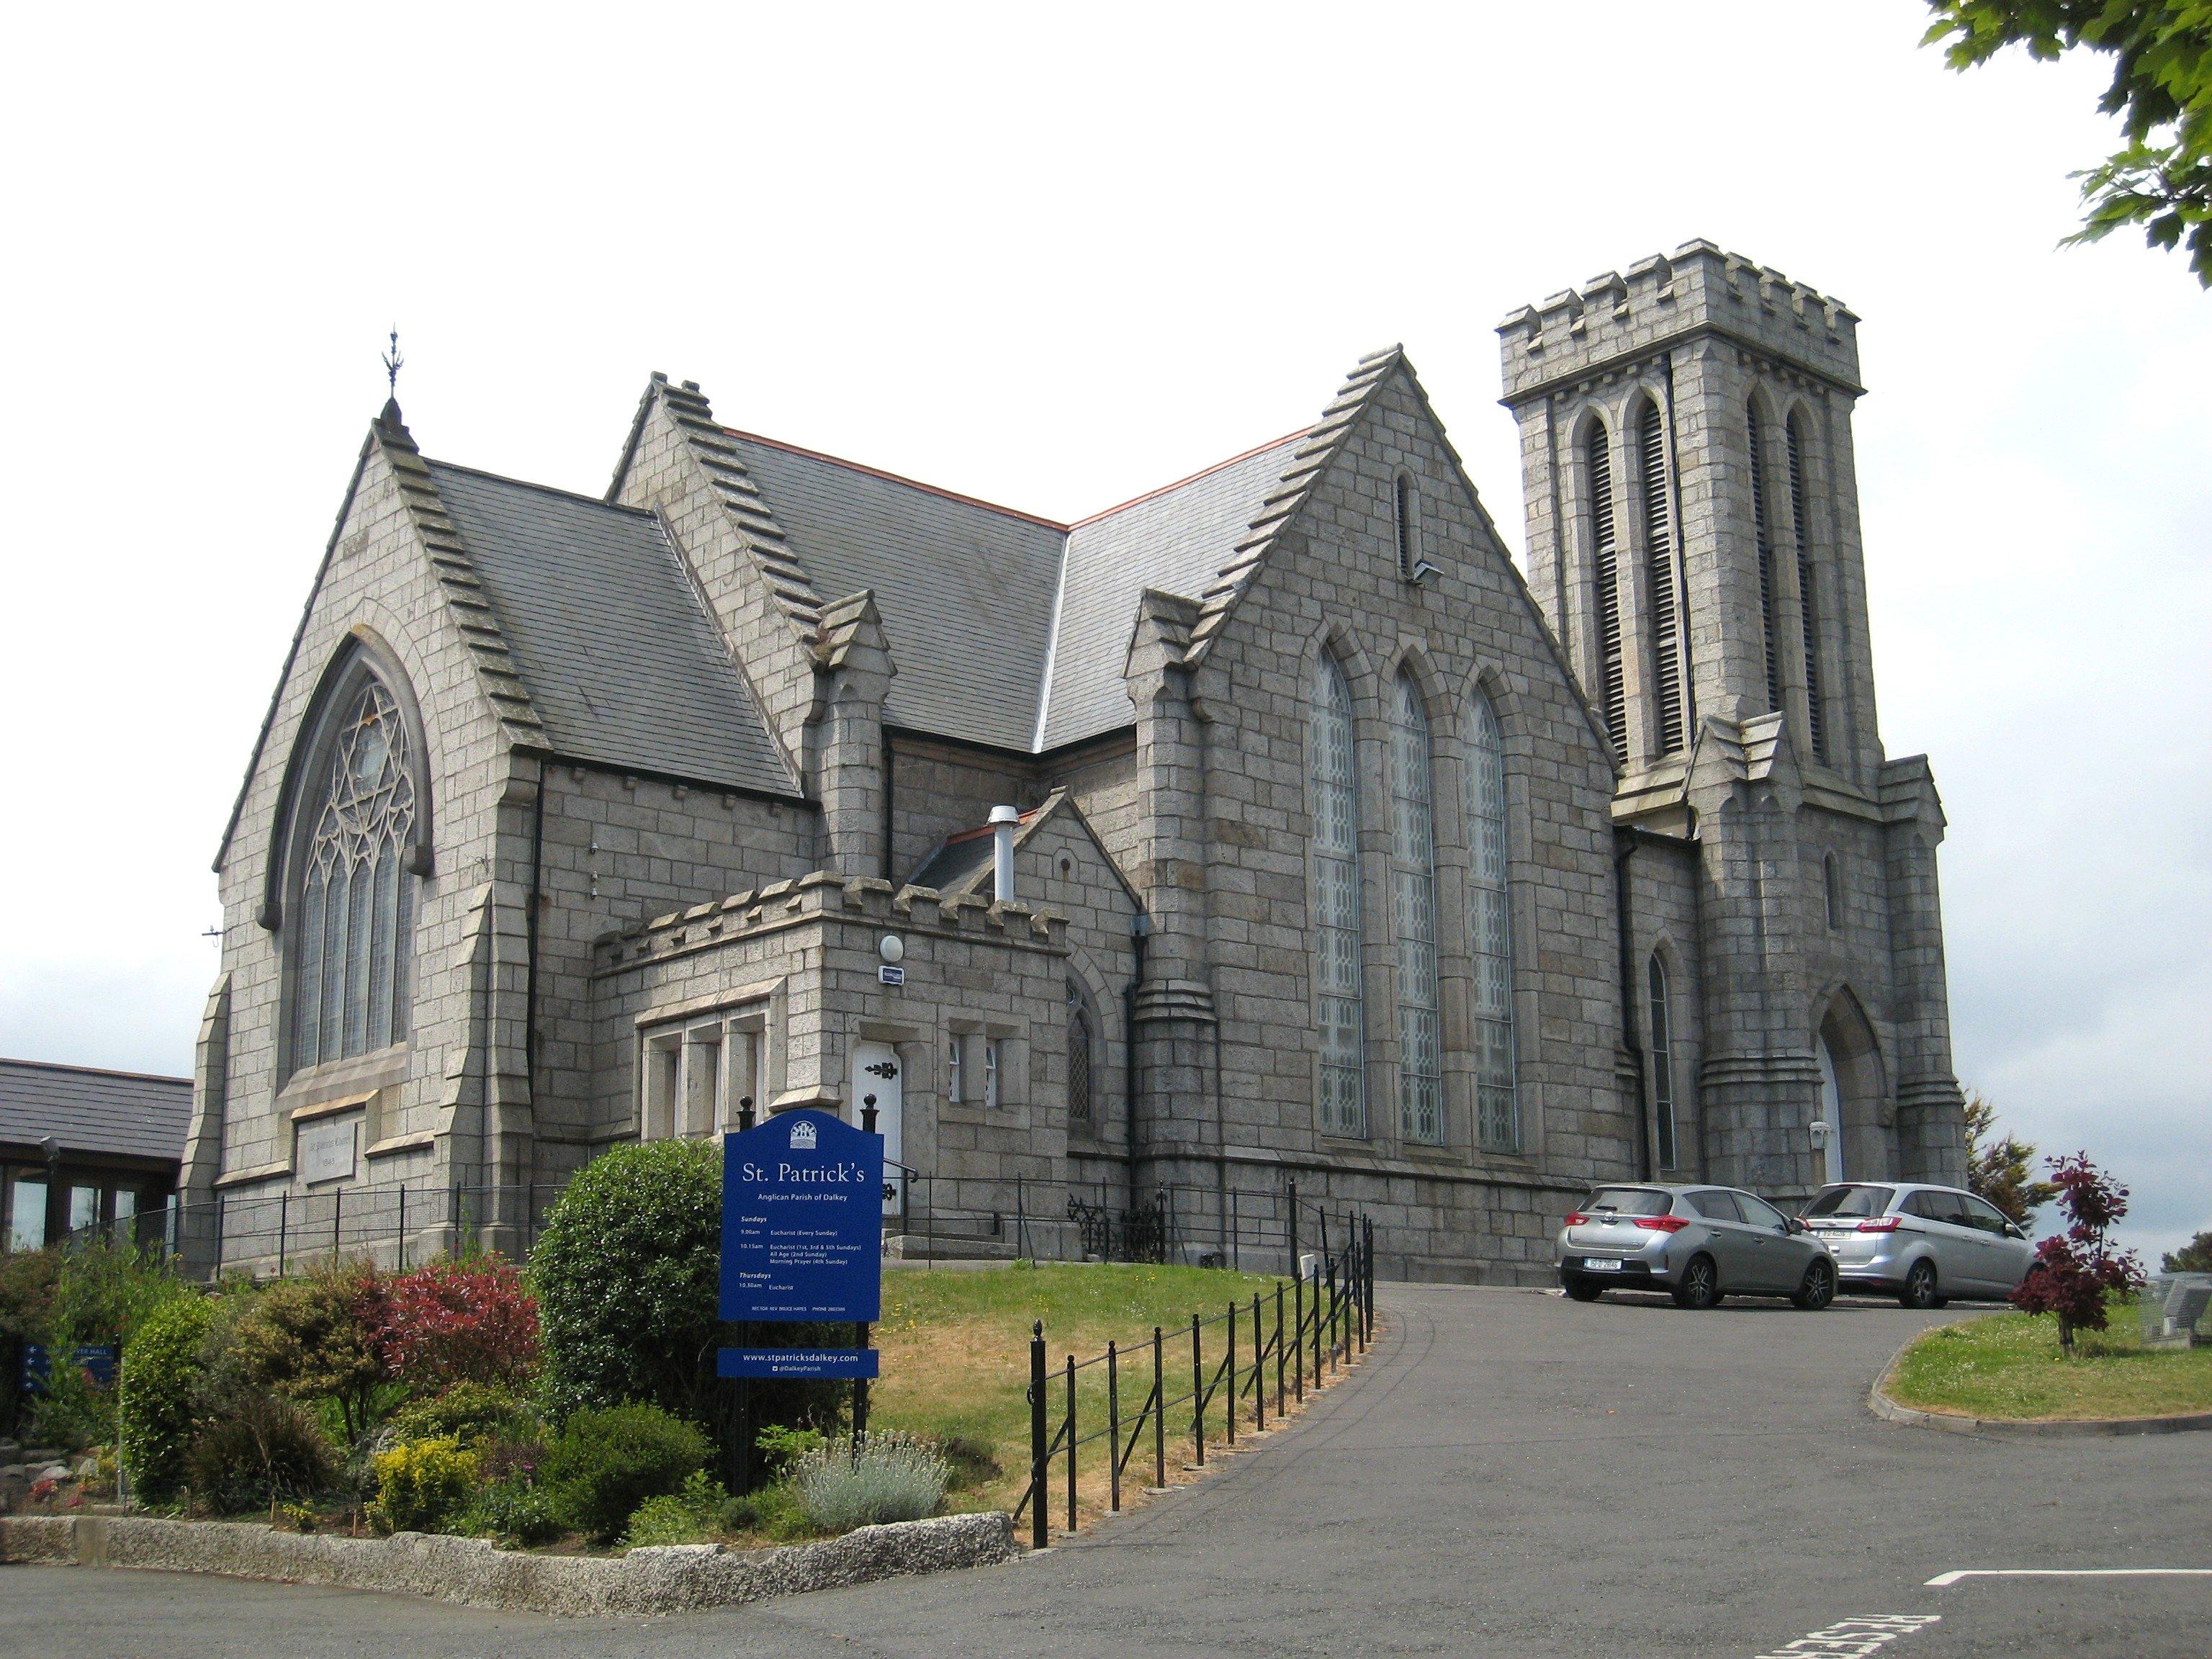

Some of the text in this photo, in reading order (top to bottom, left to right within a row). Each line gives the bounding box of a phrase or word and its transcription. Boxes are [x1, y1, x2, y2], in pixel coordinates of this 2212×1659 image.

[742, 1162, 865, 1182] St. Patrick's
[757, 1193, 789, 1202] Anglican
[743, 1353, 858, 1364] www.stpatricksdalkey.com
